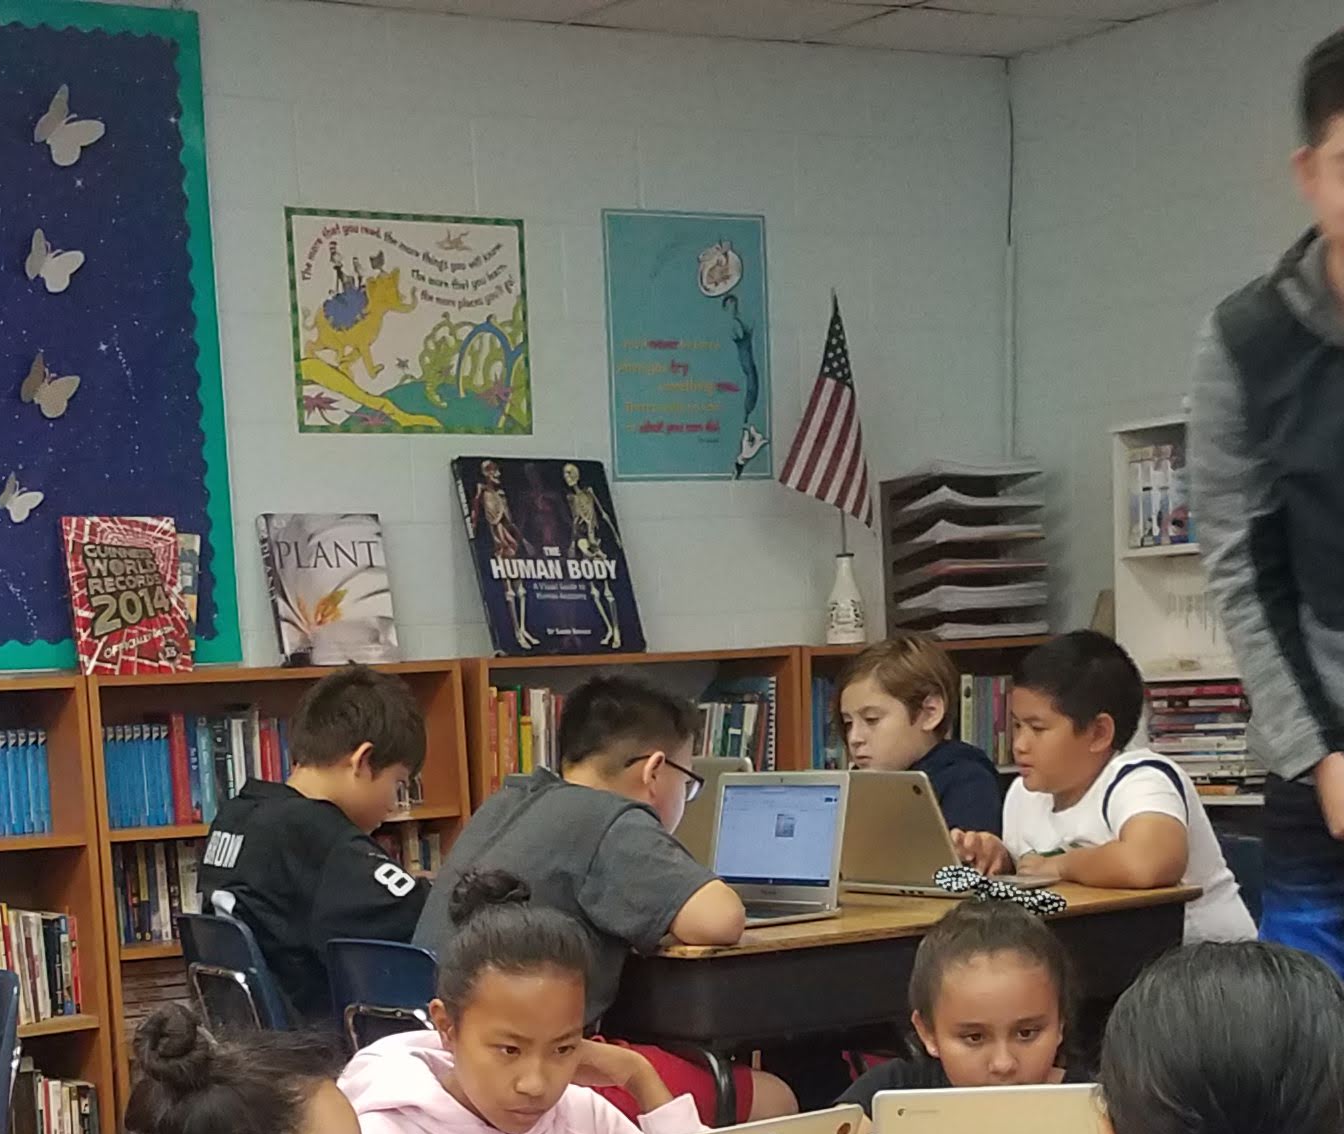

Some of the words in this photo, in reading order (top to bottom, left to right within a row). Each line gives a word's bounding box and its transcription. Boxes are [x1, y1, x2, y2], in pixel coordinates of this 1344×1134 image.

[275, 541, 379, 568] PLANT
[543, 546, 561, 556] THE
[86, 559, 157, 577] WORLD
[490, 558, 564, 580] HUMAN
[567, 558, 617, 580] BODY
[88, 573, 163, 595] RECORDS
[91, 586, 170, 637] 2014
[374, 863, 416, 897] 8
